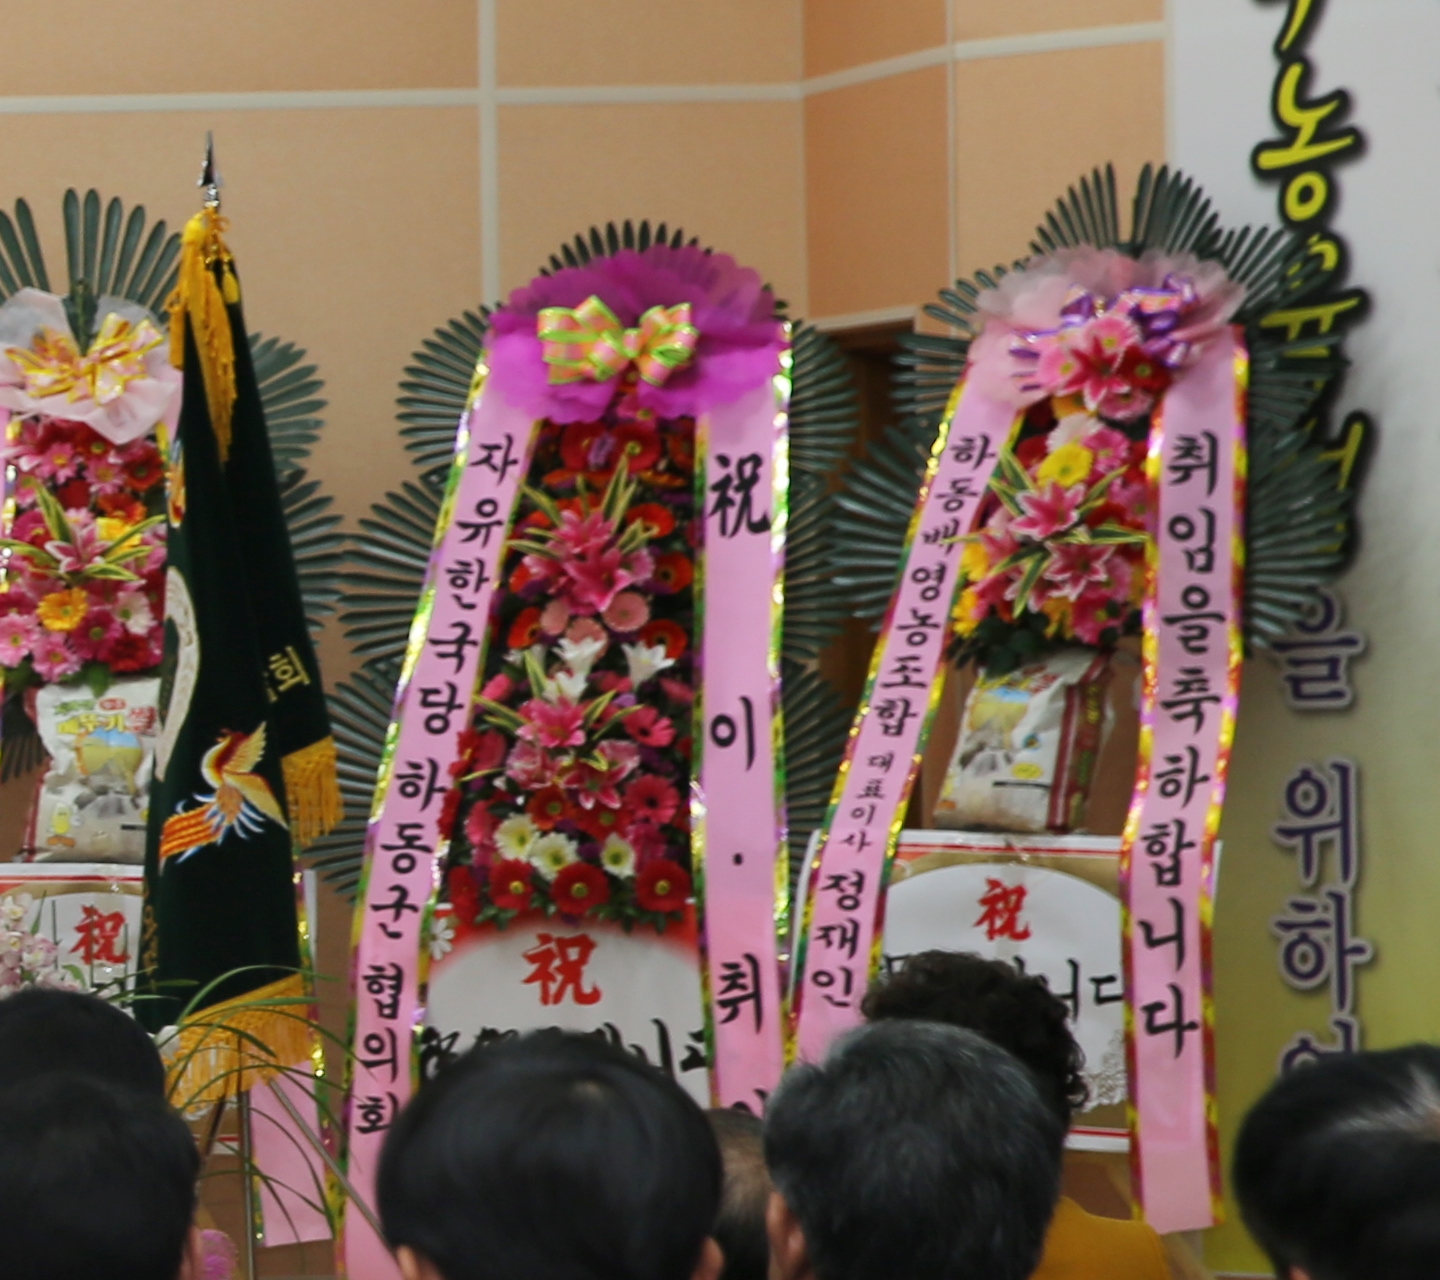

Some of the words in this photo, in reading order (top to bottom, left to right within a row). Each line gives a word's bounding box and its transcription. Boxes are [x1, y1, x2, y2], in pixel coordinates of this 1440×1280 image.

[707, 452, 772, 539] 祝
[419, 433, 520, 735] 자유한국당
[68, 904, 131, 966] 祝
[810, 870, 866, 1008] 정재인
[973, 876, 1033, 942] 祝
[520, 931, 603, 1007] 祝
